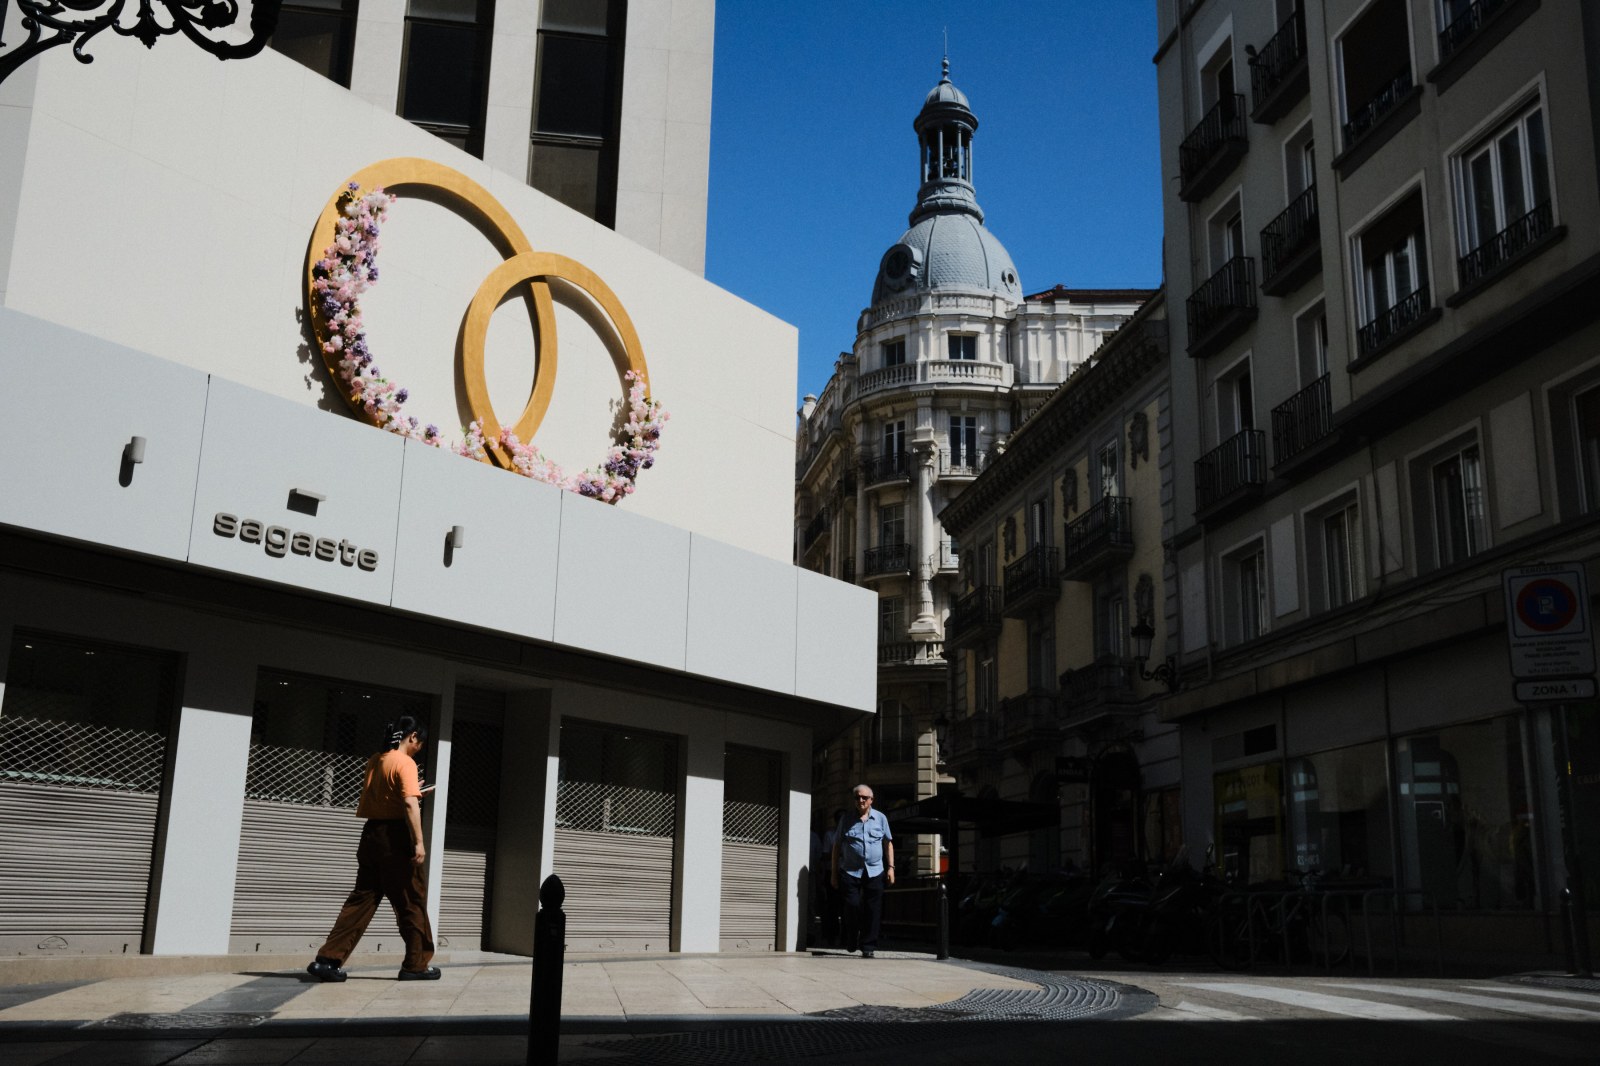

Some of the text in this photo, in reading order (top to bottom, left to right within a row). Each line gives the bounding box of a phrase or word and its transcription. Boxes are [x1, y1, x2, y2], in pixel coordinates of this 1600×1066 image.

[213, 511, 379, 572] sagaste
[1532, 684, 1577, 696] ZONA 1
